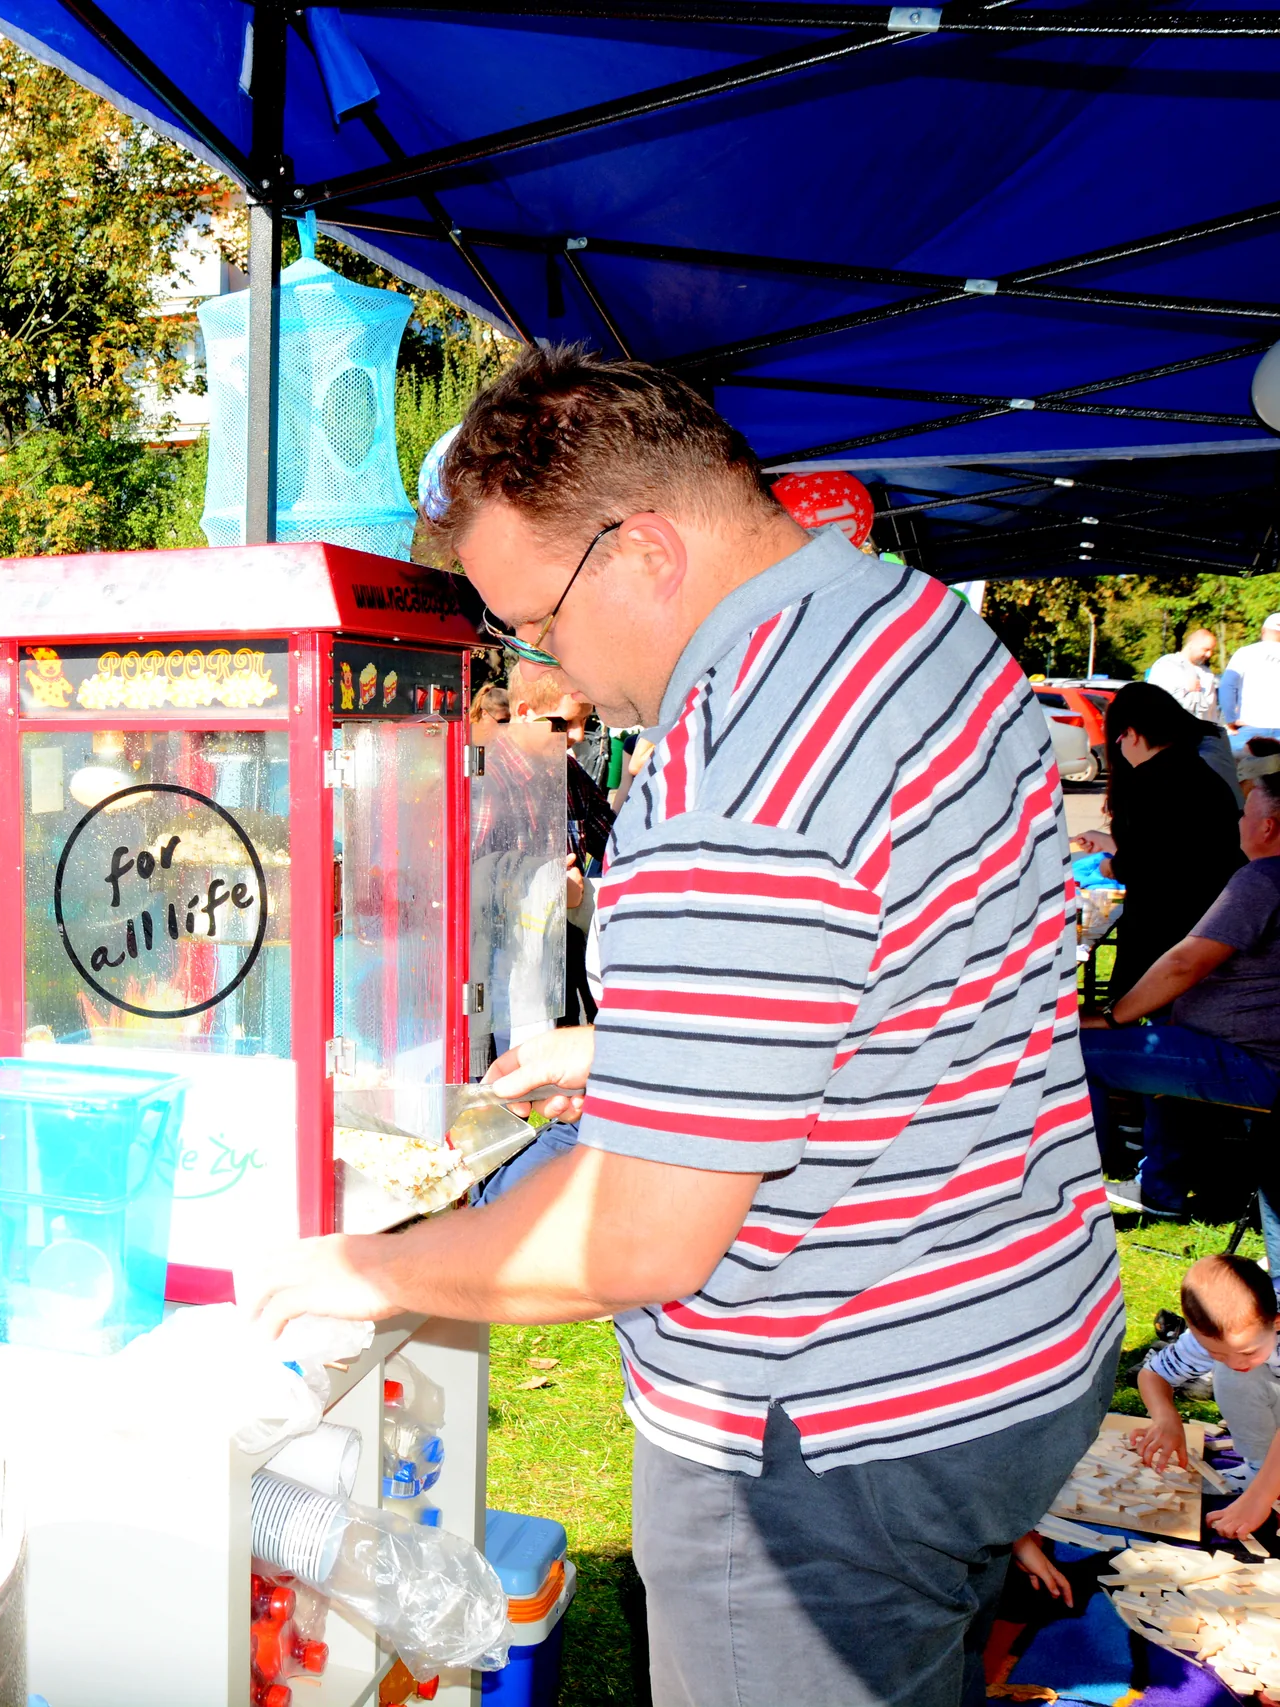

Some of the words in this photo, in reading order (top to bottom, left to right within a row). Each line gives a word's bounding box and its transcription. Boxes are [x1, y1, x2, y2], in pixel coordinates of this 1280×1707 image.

[98, 648, 272, 681] POPCORN
[105, 836, 181, 907] for
[91, 911, 153, 972] all
[168, 879, 254, 940] life
